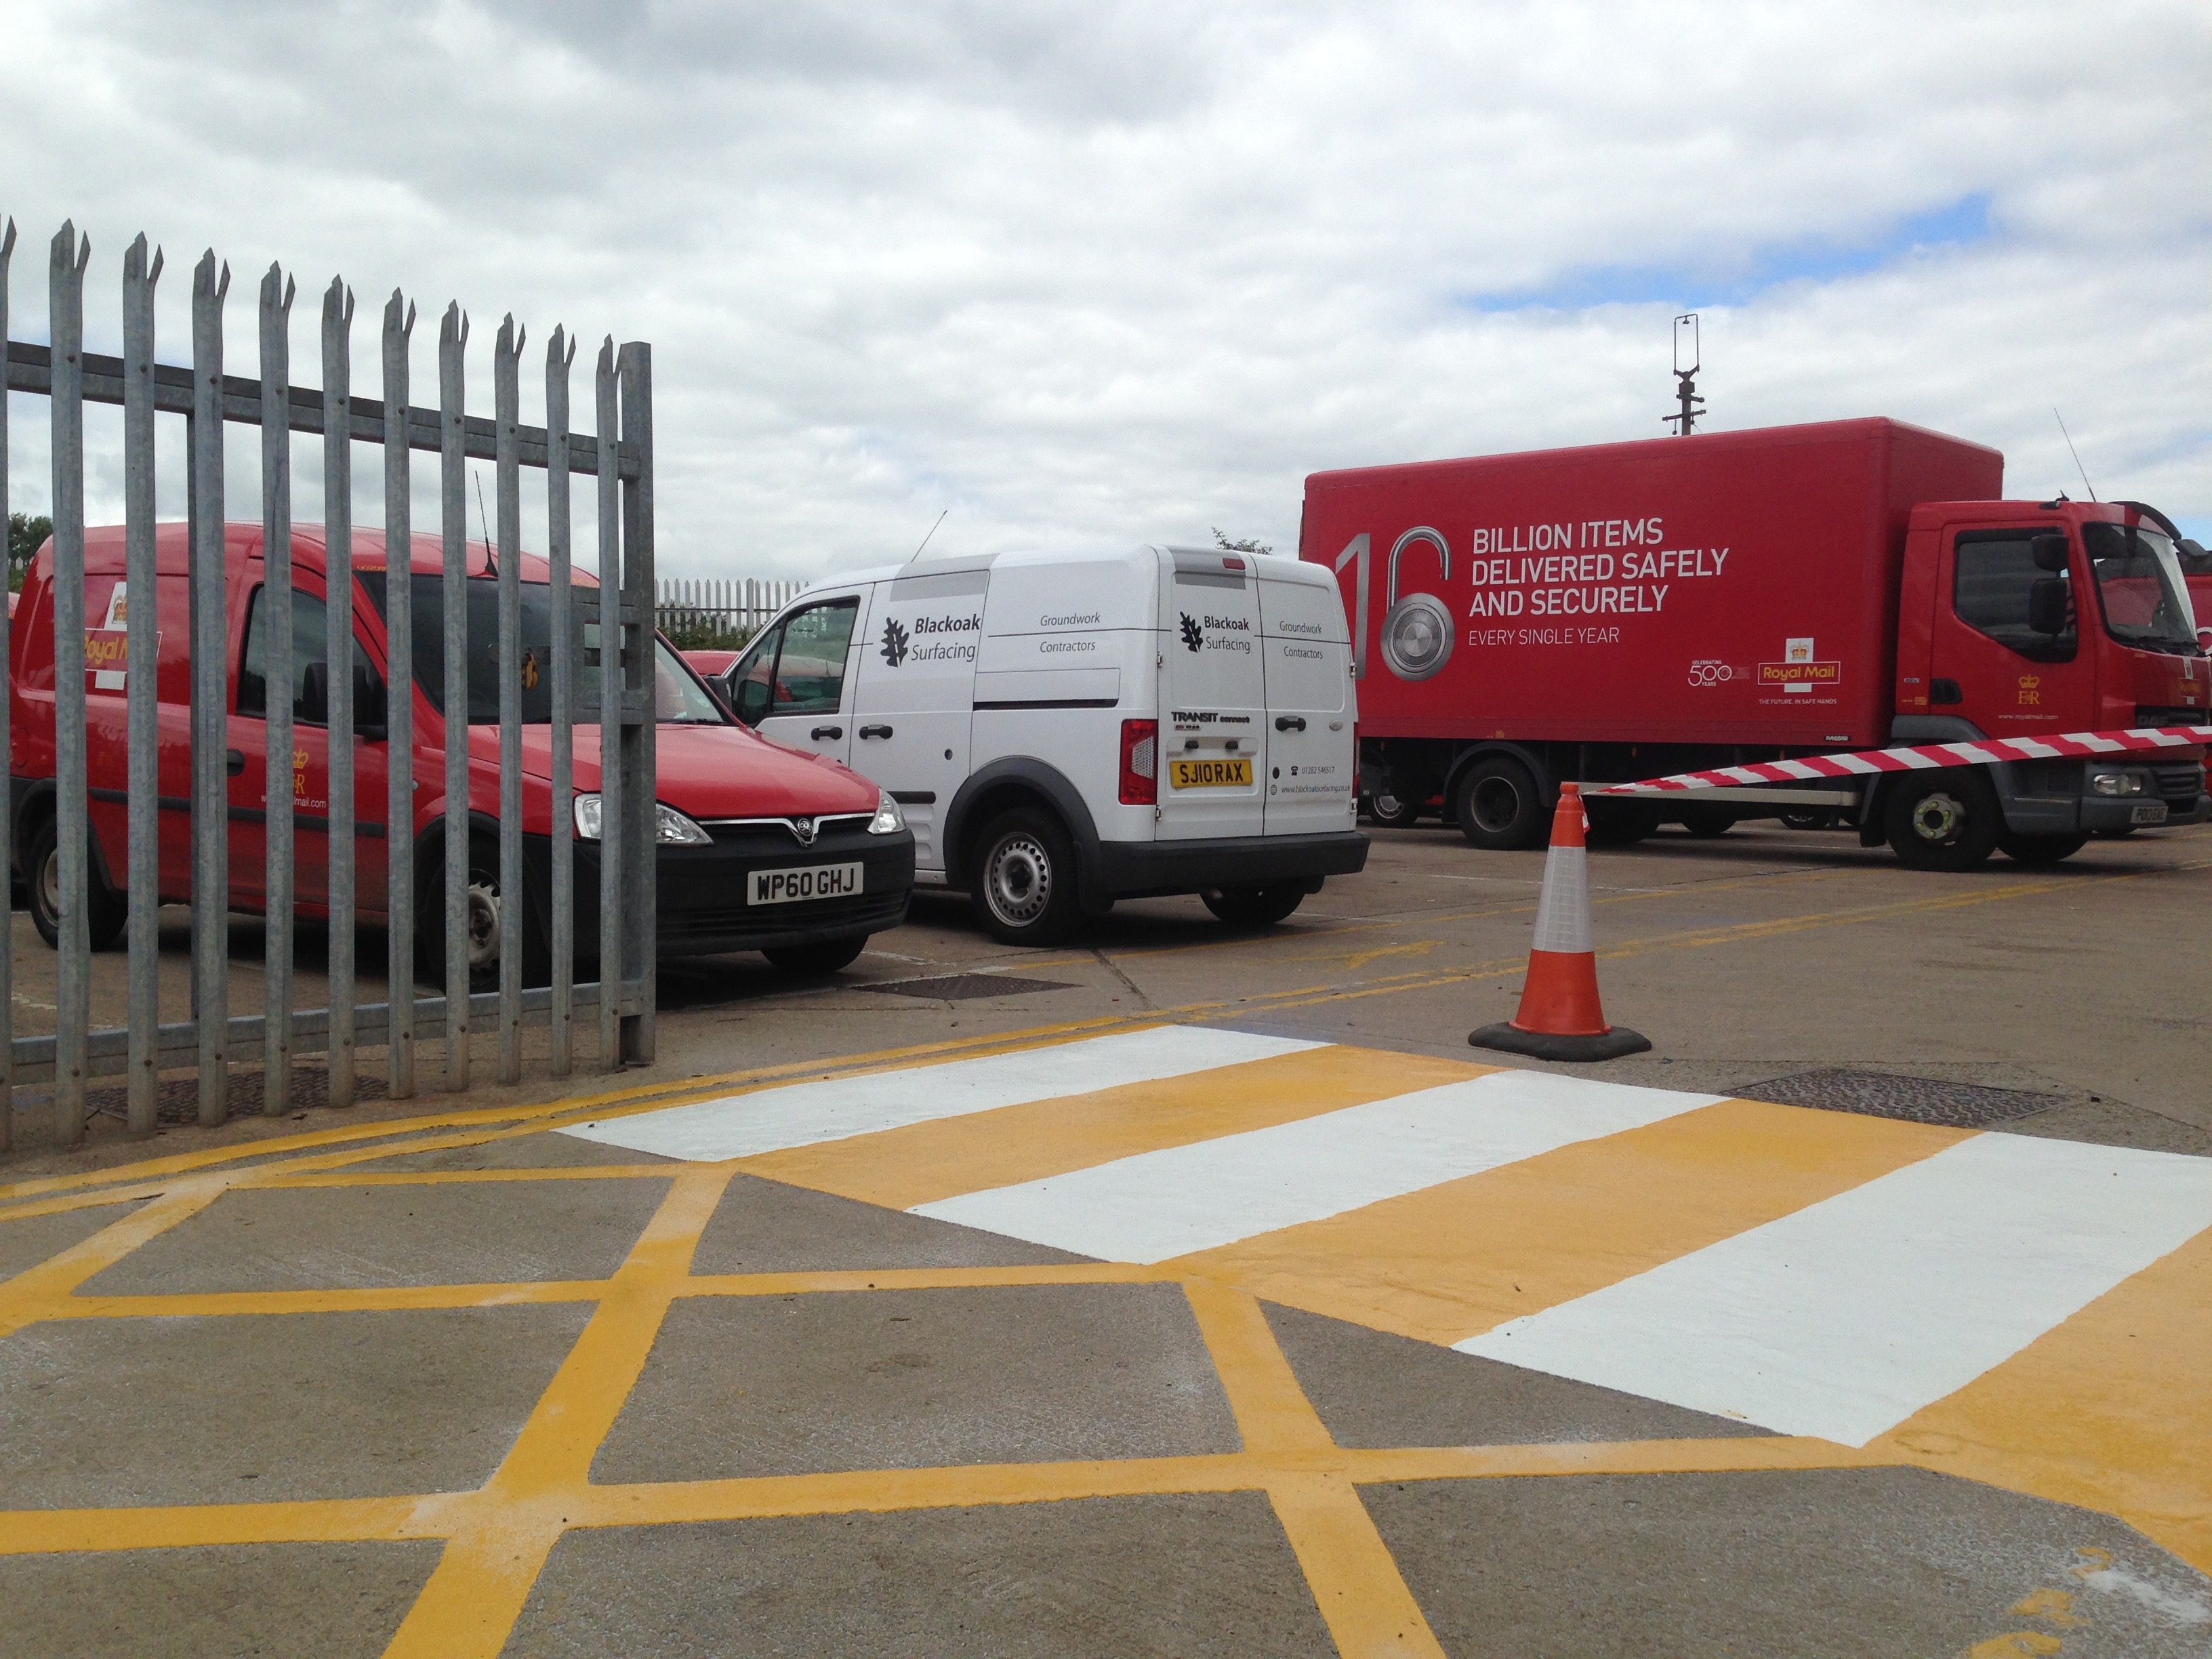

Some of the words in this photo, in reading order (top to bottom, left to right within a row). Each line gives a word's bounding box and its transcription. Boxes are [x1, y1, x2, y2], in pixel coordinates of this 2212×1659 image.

[1473, 523, 1572, 554] BILLION
[1580, 517, 1664, 548] ITEMS
[1472, 554, 1614, 586] DELIVERED
[1621, 548, 1729, 579] SAFELY
[1469, 590, 1523, 617] AND
[1530, 585, 1669, 615] SECURELY
[915, 613, 981, 634] Blackoak
[1040, 612, 1101, 627] Groundwork
[1204, 615, 1250, 631] Blackoak
[1279, 620, 1322, 634] Groundwork
[1206, 636, 1250, 654] Surfacing
[1469, 630, 1517, 646] EVERY
[1519, 628, 1574, 644] SINGLE
[1578, 627, 1620, 644] YEAR
[911, 643, 976, 663] Surfacing
[1040, 640, 1096, 653] Contractors
[1284, 646, 1324, 659] Contractors
[1687, 665, 1732, 687] 500
[1763, 666, 1801, 681] Royal
[1805, 665, 1835, 678] Mail
[1171, 712, 1218, 722] TRANSIT
[758, 872, 813, 901] WP60
[817, 868, 855, 895] GHJ
